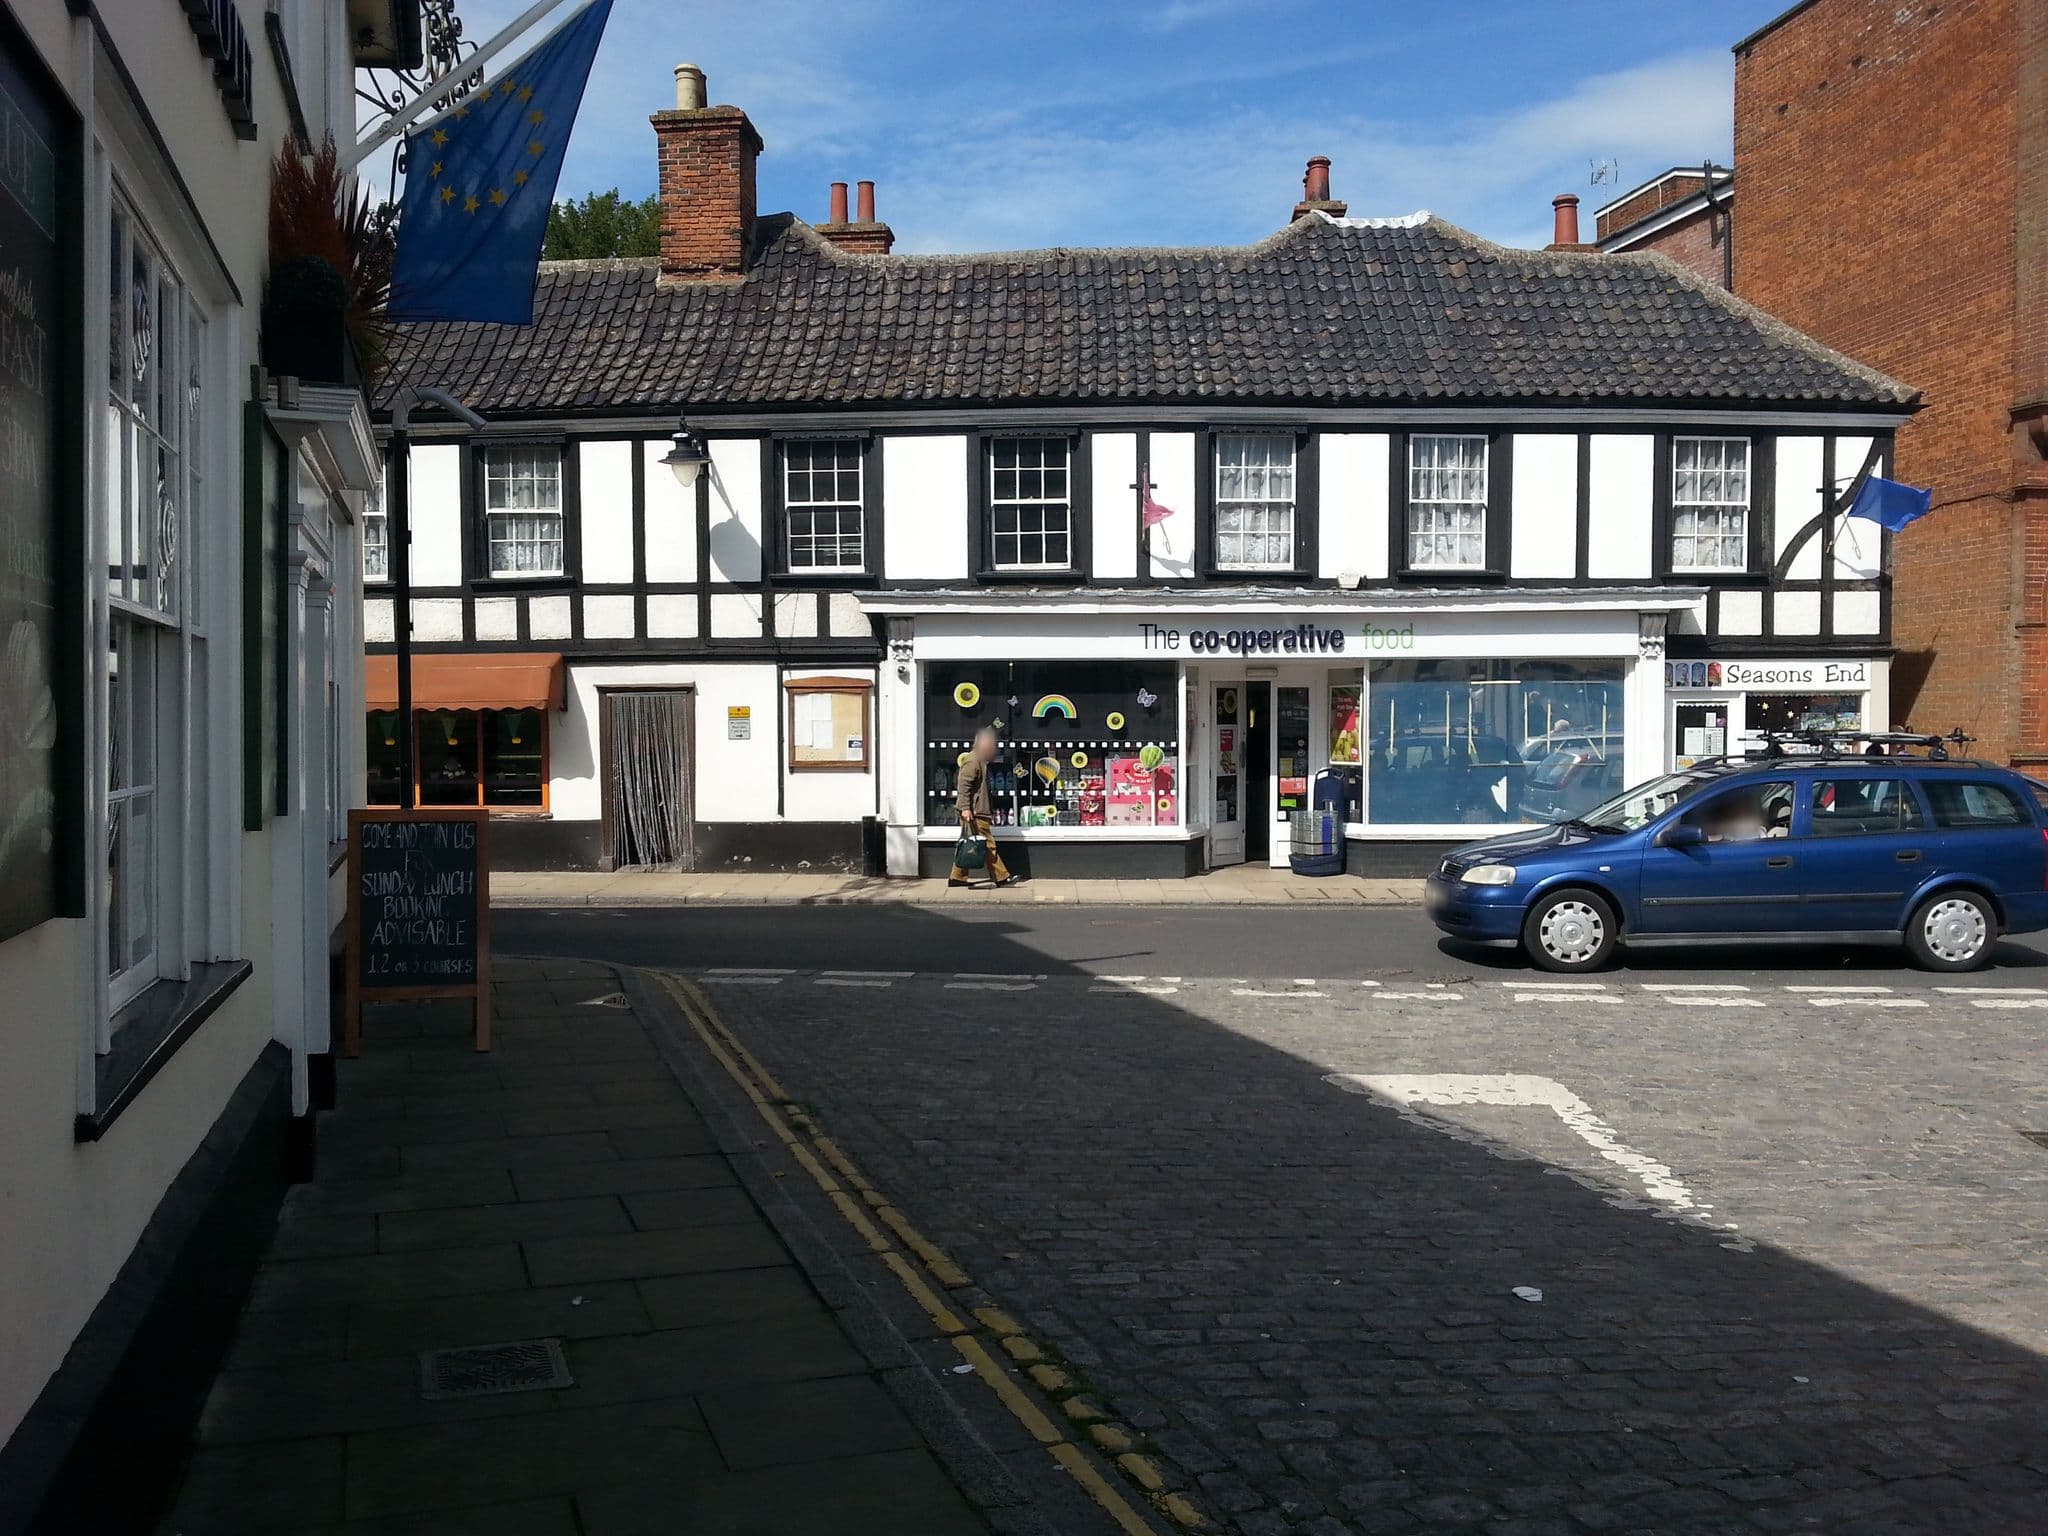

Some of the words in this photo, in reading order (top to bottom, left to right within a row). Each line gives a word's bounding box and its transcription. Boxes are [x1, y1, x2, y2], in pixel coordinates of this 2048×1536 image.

[1139, 623, 1180, 650] The
[1189, 625, 1345, 656] co-operative
[1362, 623, 1414, 650] food
[1727, 664, 1812, 684] Seasons
[1825, 663, 1865, 682] End
[363, 823, 392, 848] COME
[394, 823, 418, 848] AND
[454, 822, 475, 849] US
[423, 870, 473, 896] LUNCH
[370, 919, 466, 946] ADVISABLE
